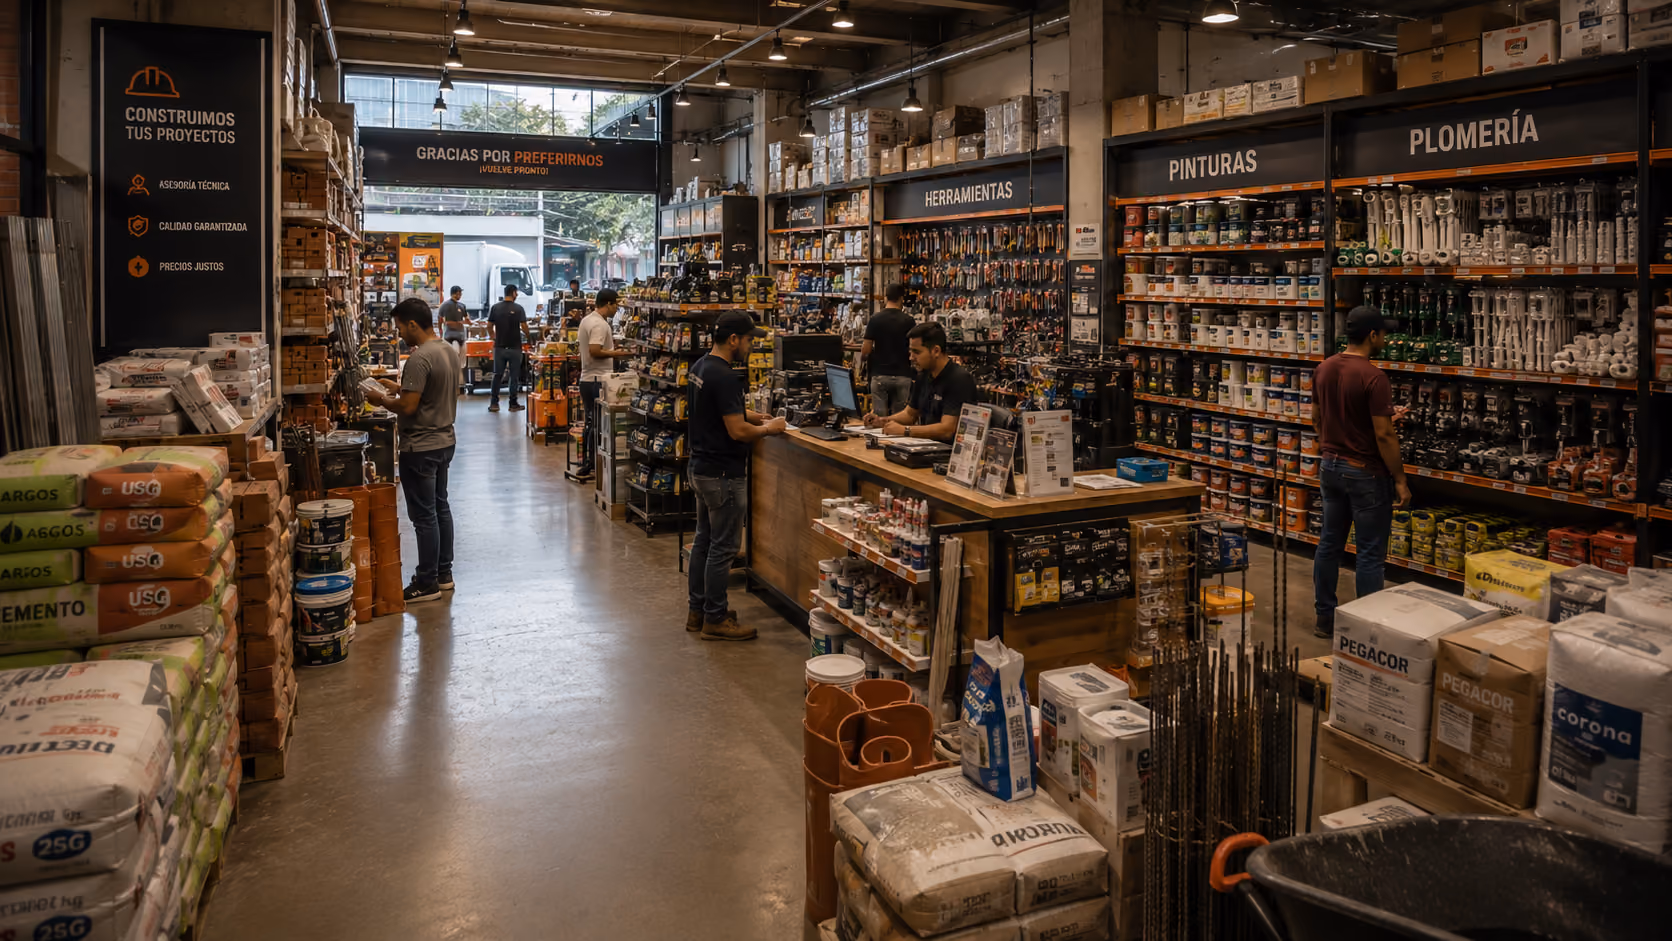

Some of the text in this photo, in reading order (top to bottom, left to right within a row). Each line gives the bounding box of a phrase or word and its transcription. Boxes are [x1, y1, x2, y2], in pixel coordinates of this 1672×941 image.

[125, 107, 235, 127] CONSTRUIMOS
[125, 126, 236, 144] TUS PROYECTOS
[1410, 108, 1540, 155] PLOMERÍA
[416, 146, 604, 167] GRACIAS POR PREFERIRNOS
[1169, 149, 1257, 181] PINTURAS
[197, 180, 230, 191] TÉCNICA
[925, 181, 1013, 207] HERRAMIENTAS
[159, 221, 248, 232] CALIDAD GARANTIZADA
[159, 262, 224, 271] PRECIOS JUSTOS
[1, 489, 59, 502] ARGOS
[0, 600, 85, 623] EMENTO
[1340, 635, 1409, 674] PEGACOR
[1442, 672, 1514, 714] PEGACOR
[1557, 707, 1632, 745] corona
[38, 833, 85, 856] 25G
